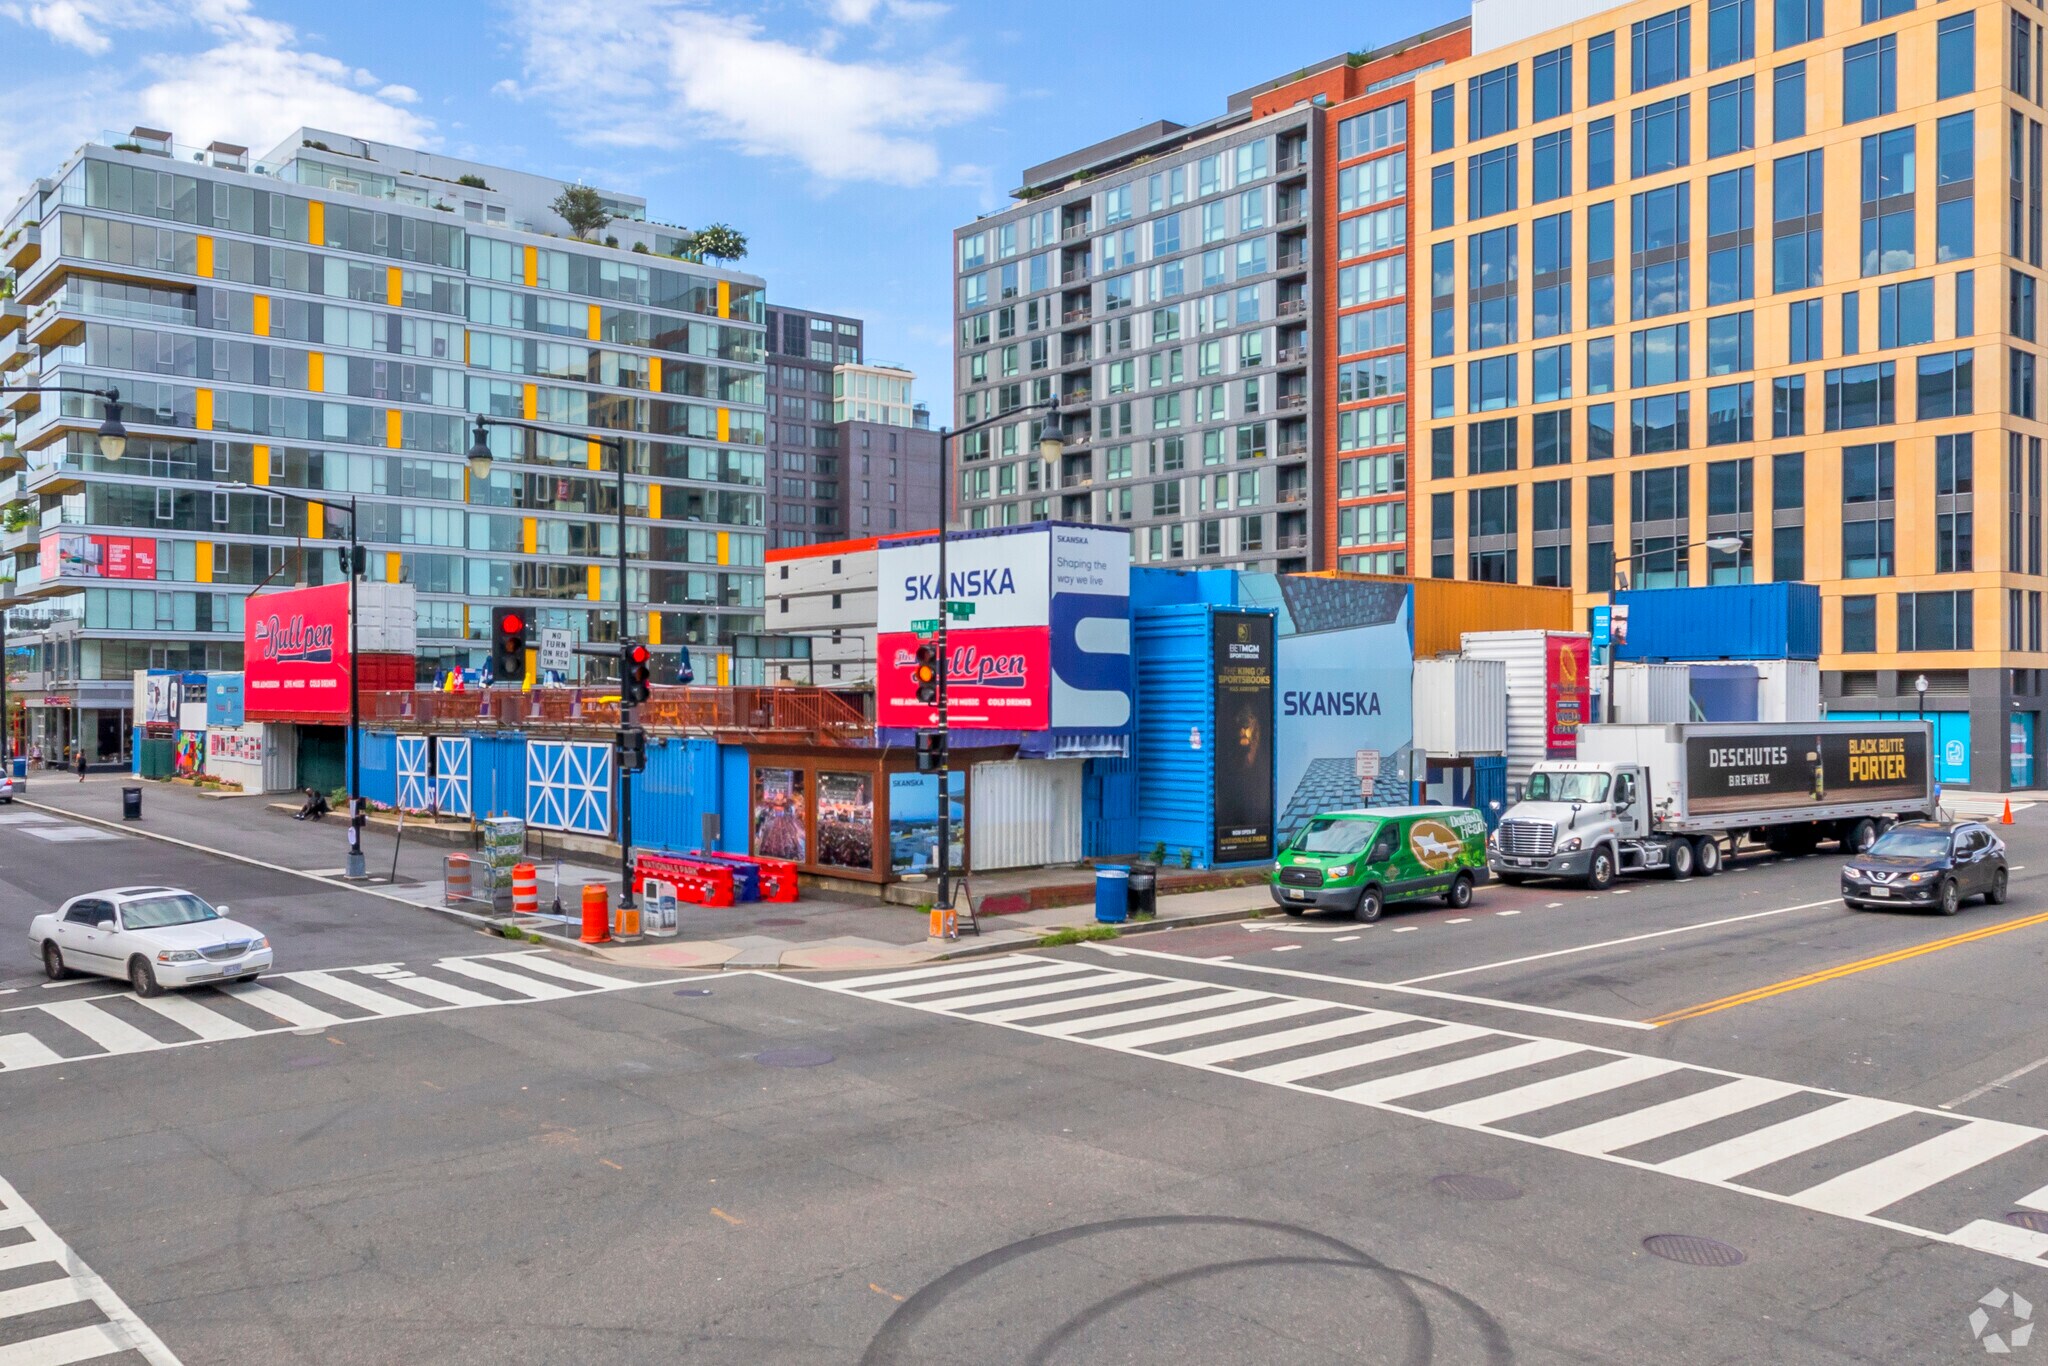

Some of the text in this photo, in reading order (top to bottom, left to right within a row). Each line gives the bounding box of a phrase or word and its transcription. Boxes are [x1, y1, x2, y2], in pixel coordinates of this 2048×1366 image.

[1057, 535, 1088, 544] SKANSKA
[1057, 556, 1107, 571] Shaping the
[904, 567, 1015, 601] SKANSKA
[1057, 576, 1074, 585] way
[1090, 575, 1103, 585] live
[912, 621, 930, 630] HALF
[264, 614, 333, 659] Bullpen
[551, 632, 562, 640] NO
[546, 640, 566, 649] TURN
[1229, 644, 1260, 653] BETMGM
[542, 649, 569, 658] ON RED
[1224, 667, 1266, 676] THE KING OF
[310, 679, 321, 688] COLD
[321, 679, 337, 688] DRINKS
[1218, 675, 1271, 685] SPORTSBOOKS
[891, 698, 905, 706] FREE
[959, 698, 979, 706] MUSIC
[987, 698, 1005, 706] COLD
[1006, 698, 1032, 707] DRINKS
[1283, 691, 1382, 716] SKANSKA
[1849, 738, 1905, 754] BLACK BUTTE
[1709, 747, 1788, 767] DESCHUTES
[1849, 755, 1906, 781] PORTER
[892, 779, 924, 787] SKANSKA
[1728, 773, 1769, 786] BREWERY
[1450, 811, 1479, 828] Dogfish
[1460, 820, 1484, 840] Head
[1220, 835, 1267, 844] NATIONALS PARK
[642, 860, 698, 876] NATIONALS PARK
